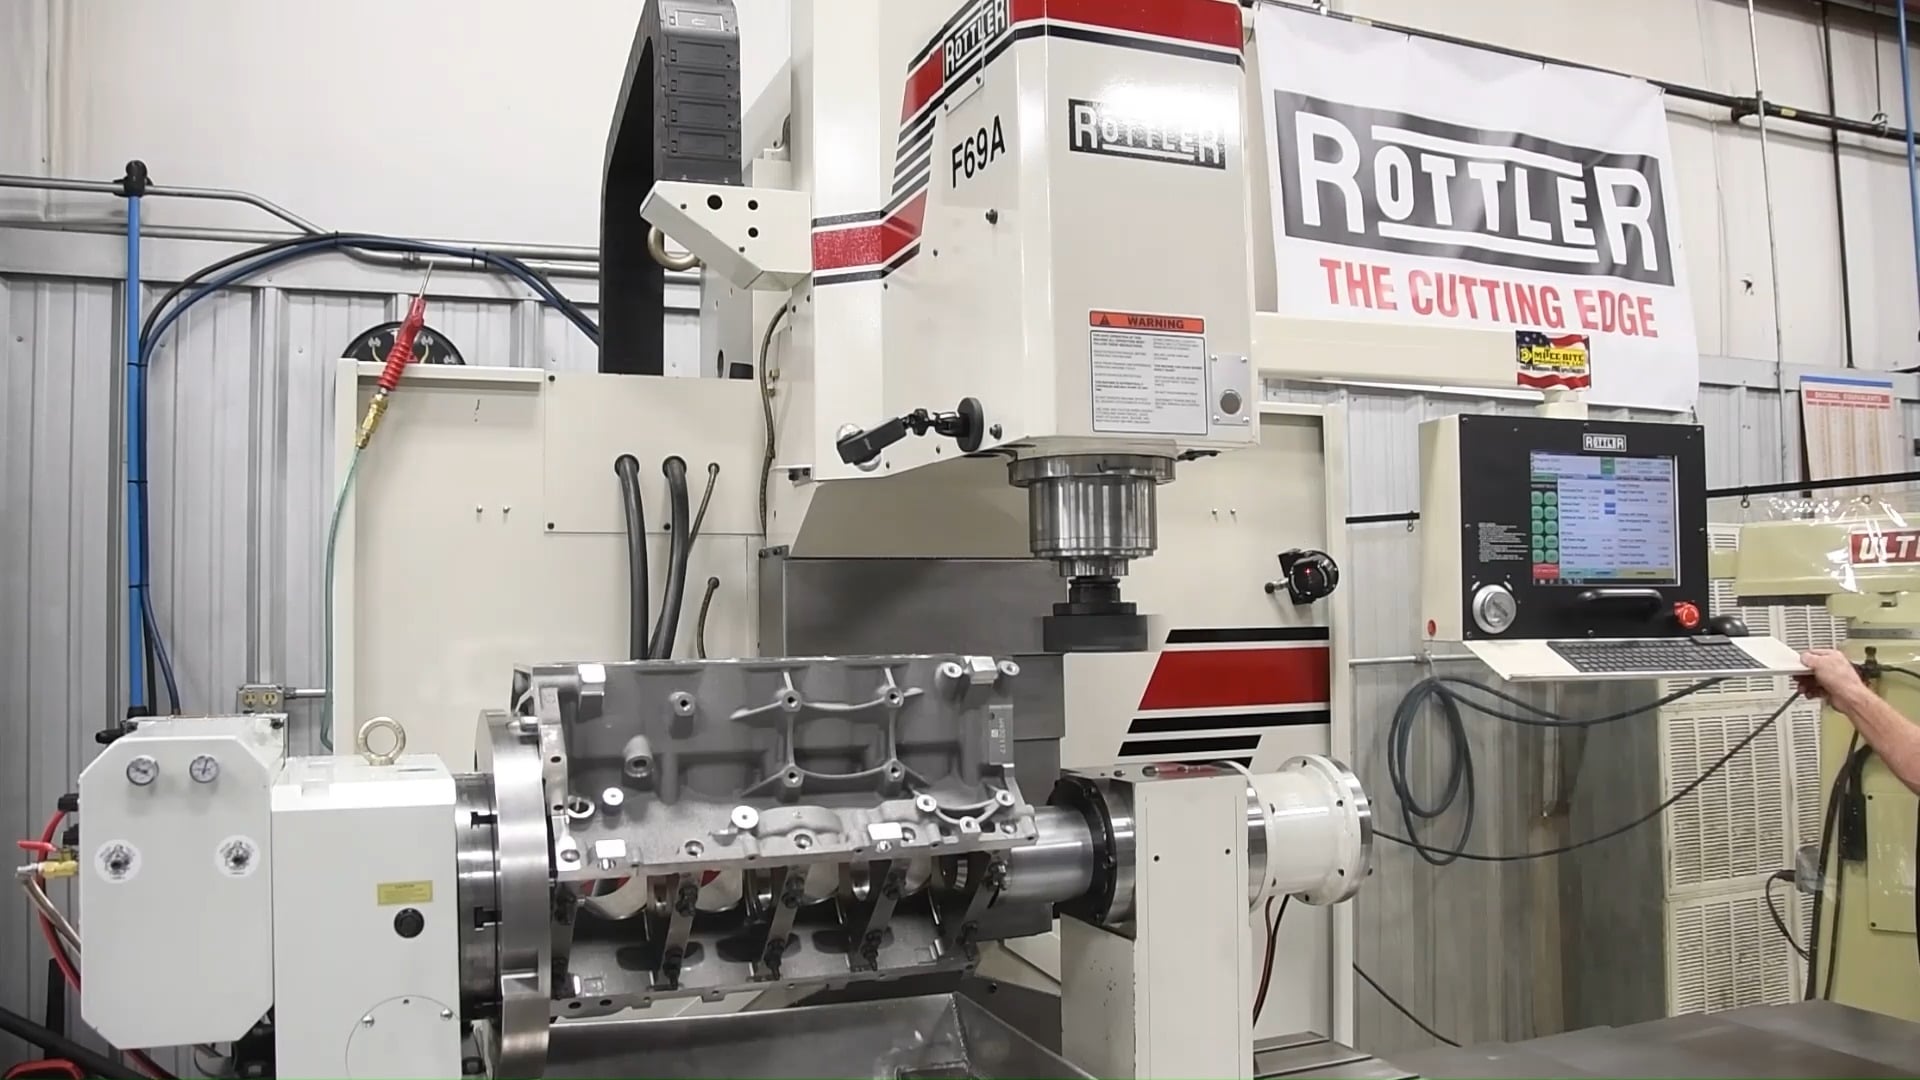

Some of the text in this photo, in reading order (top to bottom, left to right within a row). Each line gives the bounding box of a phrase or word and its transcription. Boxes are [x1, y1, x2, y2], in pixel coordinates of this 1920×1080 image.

[945, 0, 1005, 77] ROTTLER
[952, 114, 1006, 189] F69A
[1296, 111, 1659, 272] ROTTLER
[1127, 316, 1185, 329] WARNING
[1319, 258, 1659, 338] THE CUTTING EDGE
[1859, 535, 1920, 560] ULT
